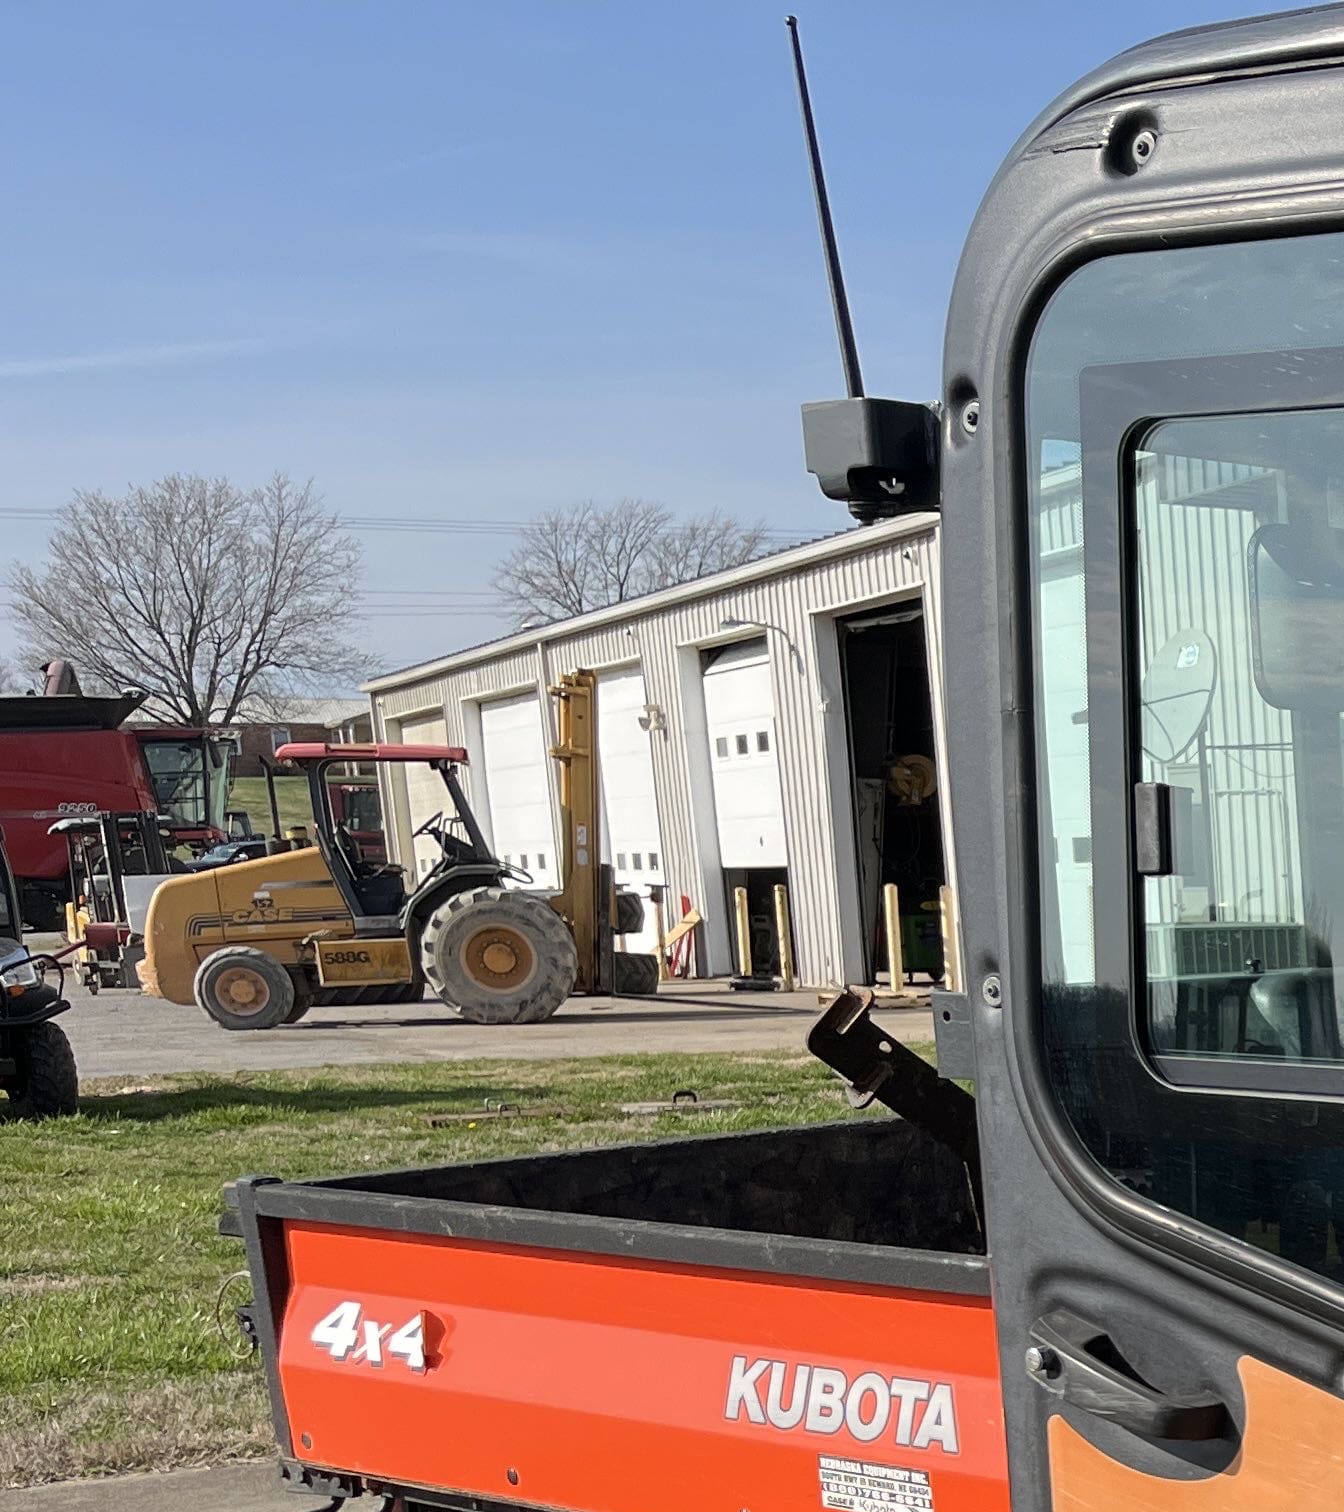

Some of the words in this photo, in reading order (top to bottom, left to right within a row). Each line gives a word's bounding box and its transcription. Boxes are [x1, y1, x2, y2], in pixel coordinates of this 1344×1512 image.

[231, 908, 294, 924] CASE
[310, 1300, 427, 1372] 4x4
[724, 1355, 960, 1455] KUBOTA
[819, 1456, 861, 1474] NEBRASKA
[862, 1464, 910, 1481] EQUIPMENT
